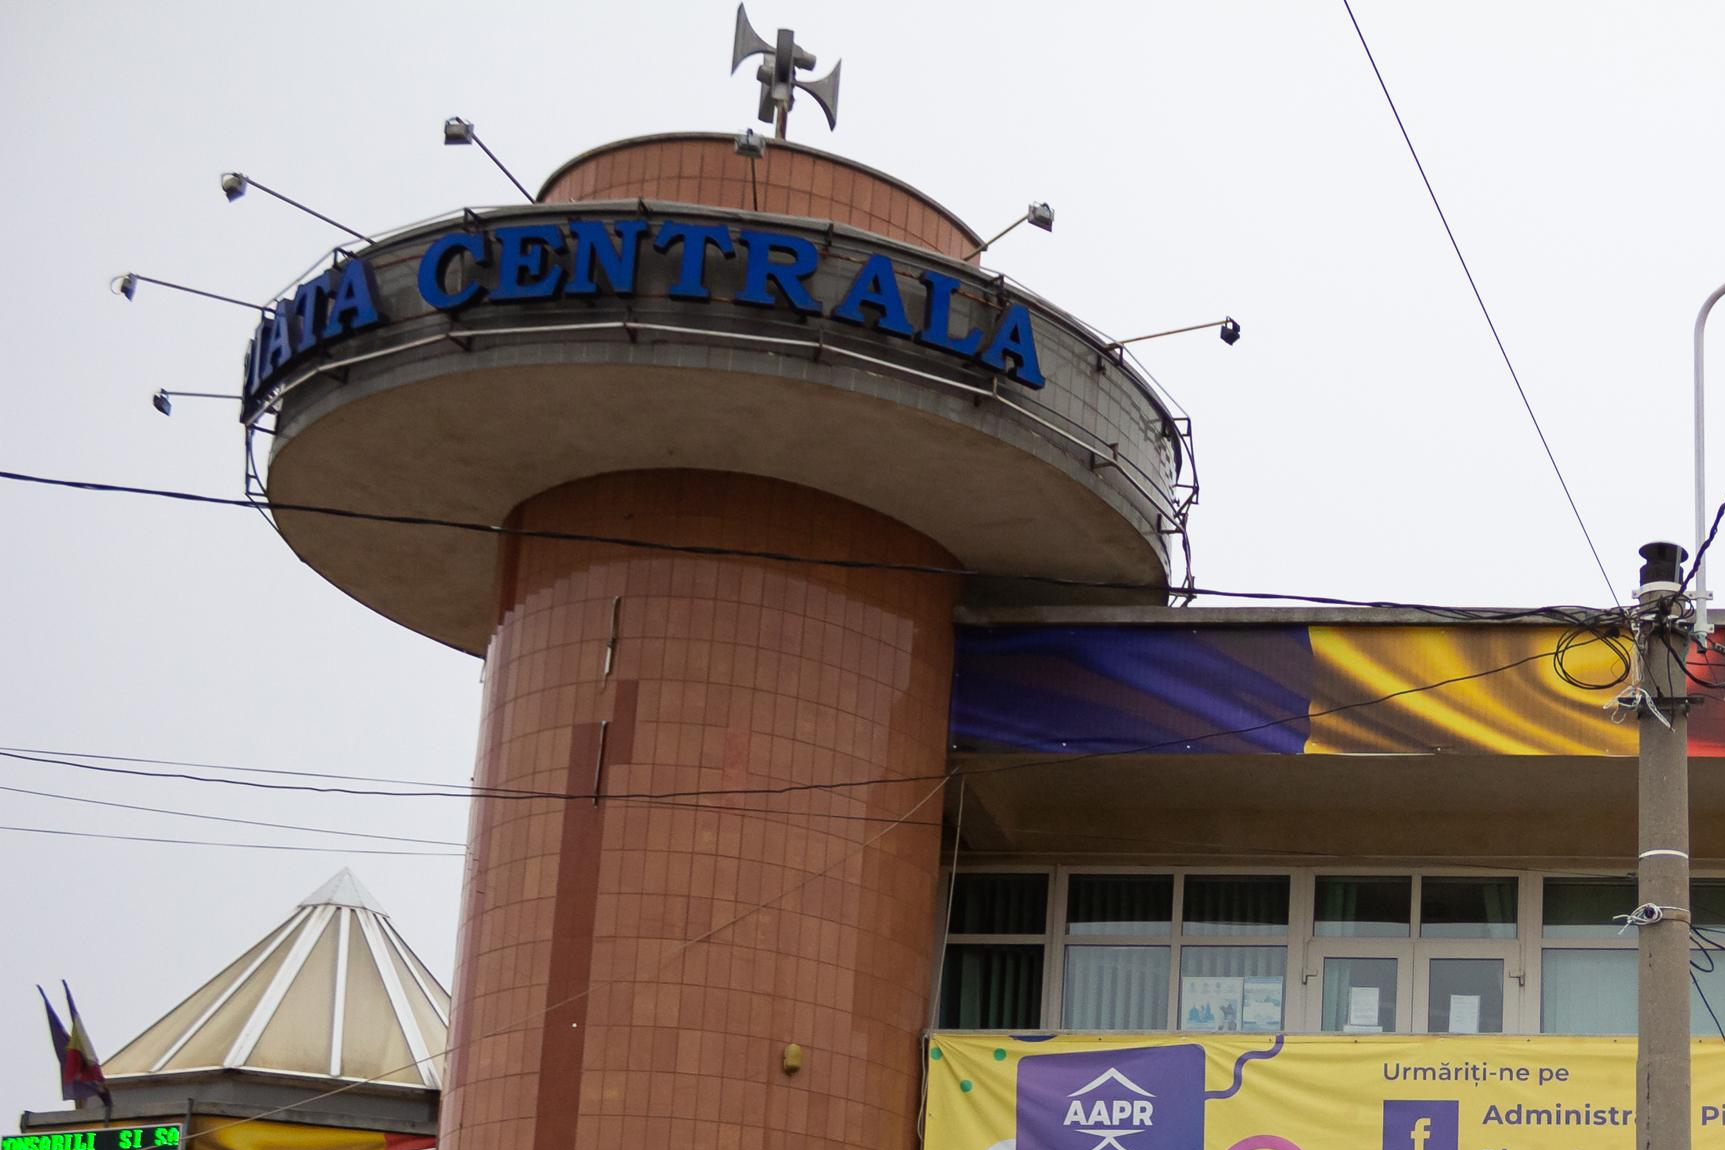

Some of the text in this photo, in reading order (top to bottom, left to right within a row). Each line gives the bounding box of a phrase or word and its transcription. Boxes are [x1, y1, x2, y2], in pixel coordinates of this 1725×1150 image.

[243, 218, 1047, 398] IATA CENTRALA
[1383, 1062, 1570, 1087] Urmăriți-ne pe
[1063, 1099, 1154, 1127] AAPR
[1482, 1103, 1637, 1126] Administr
[119, 1130, 143, 1149] SI
